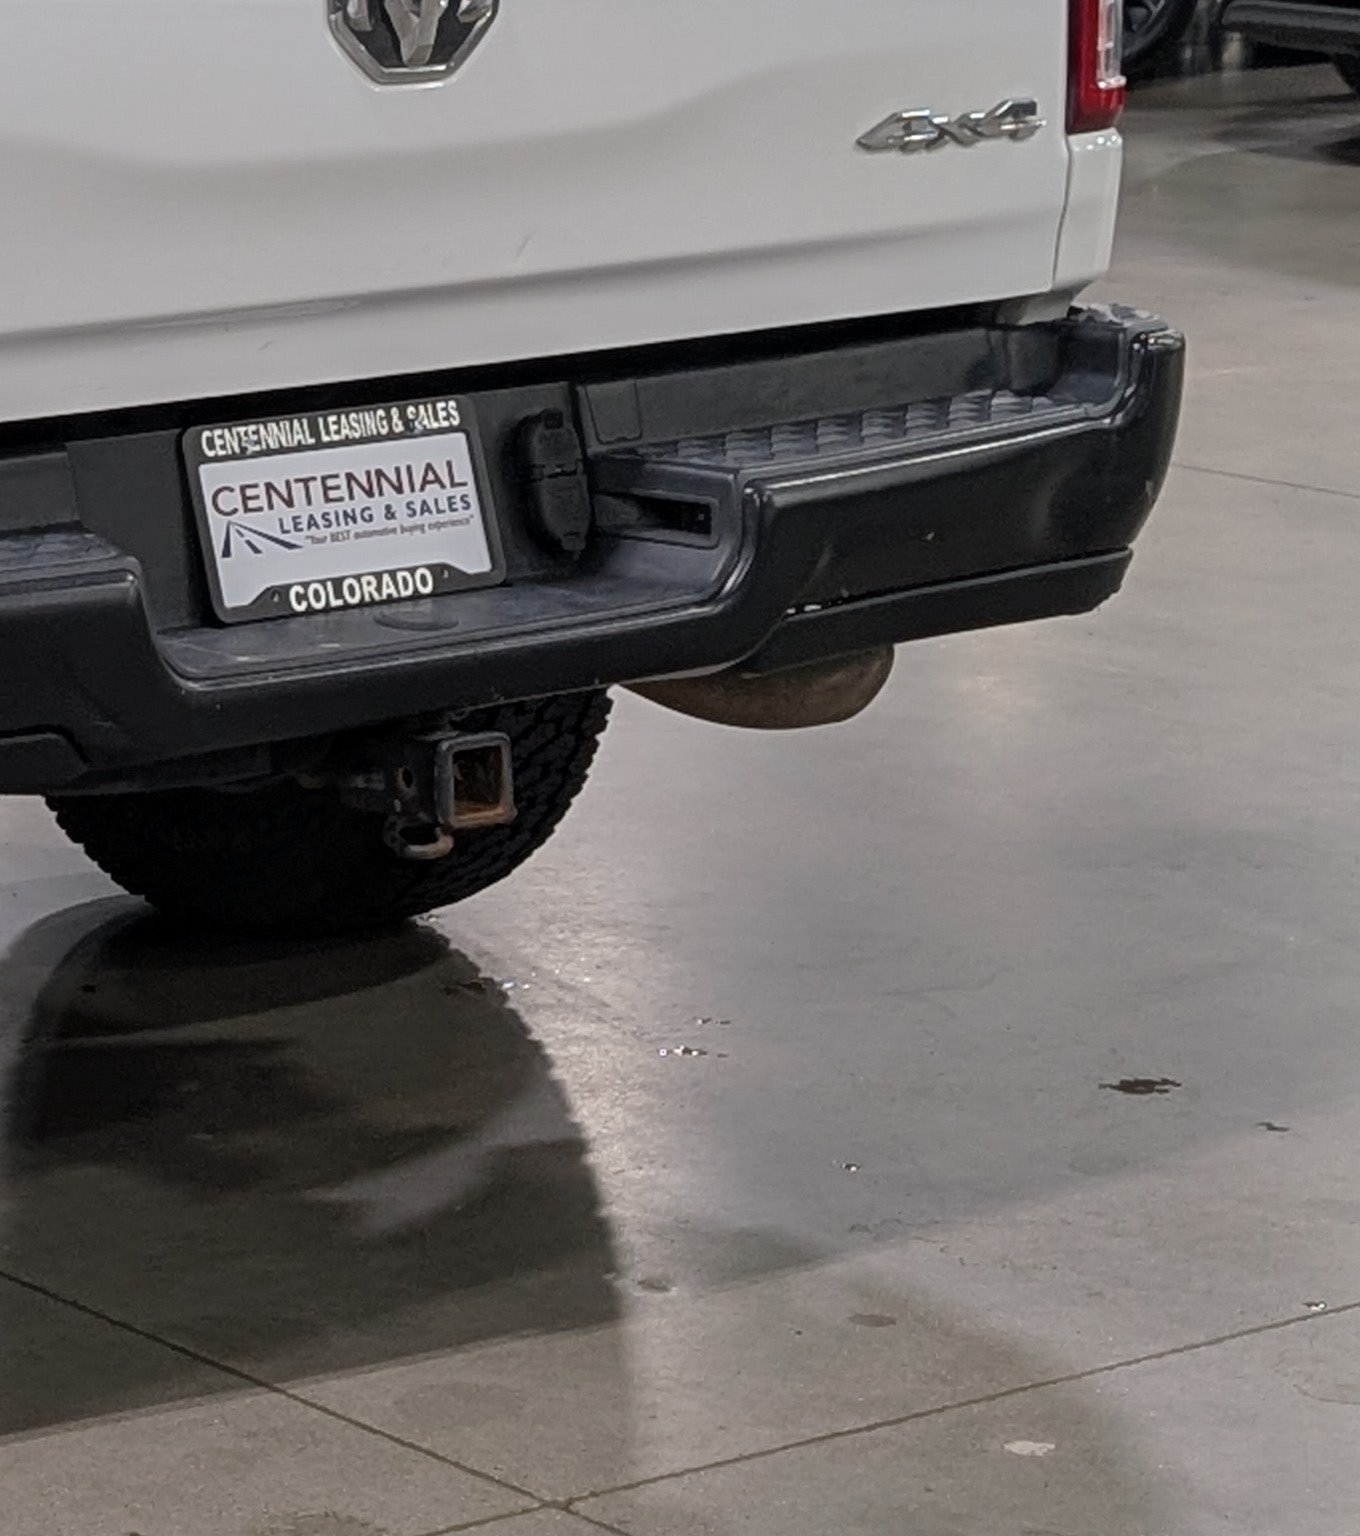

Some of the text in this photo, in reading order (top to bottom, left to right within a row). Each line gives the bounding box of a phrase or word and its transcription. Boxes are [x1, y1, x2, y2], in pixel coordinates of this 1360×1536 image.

[201, 400, 461, 457] CENTENNIAL LEASING & SALES
[211, 460, 469, 517] CENTENNIAL
[278, 493, 472, 535] LEASING & SALES
[330, 529, 351, 543] BEST
[354, 526, 398, 540] automotive
[400, 523, 425, 536] buying
[288, 566, 434, 613] COLORADO
